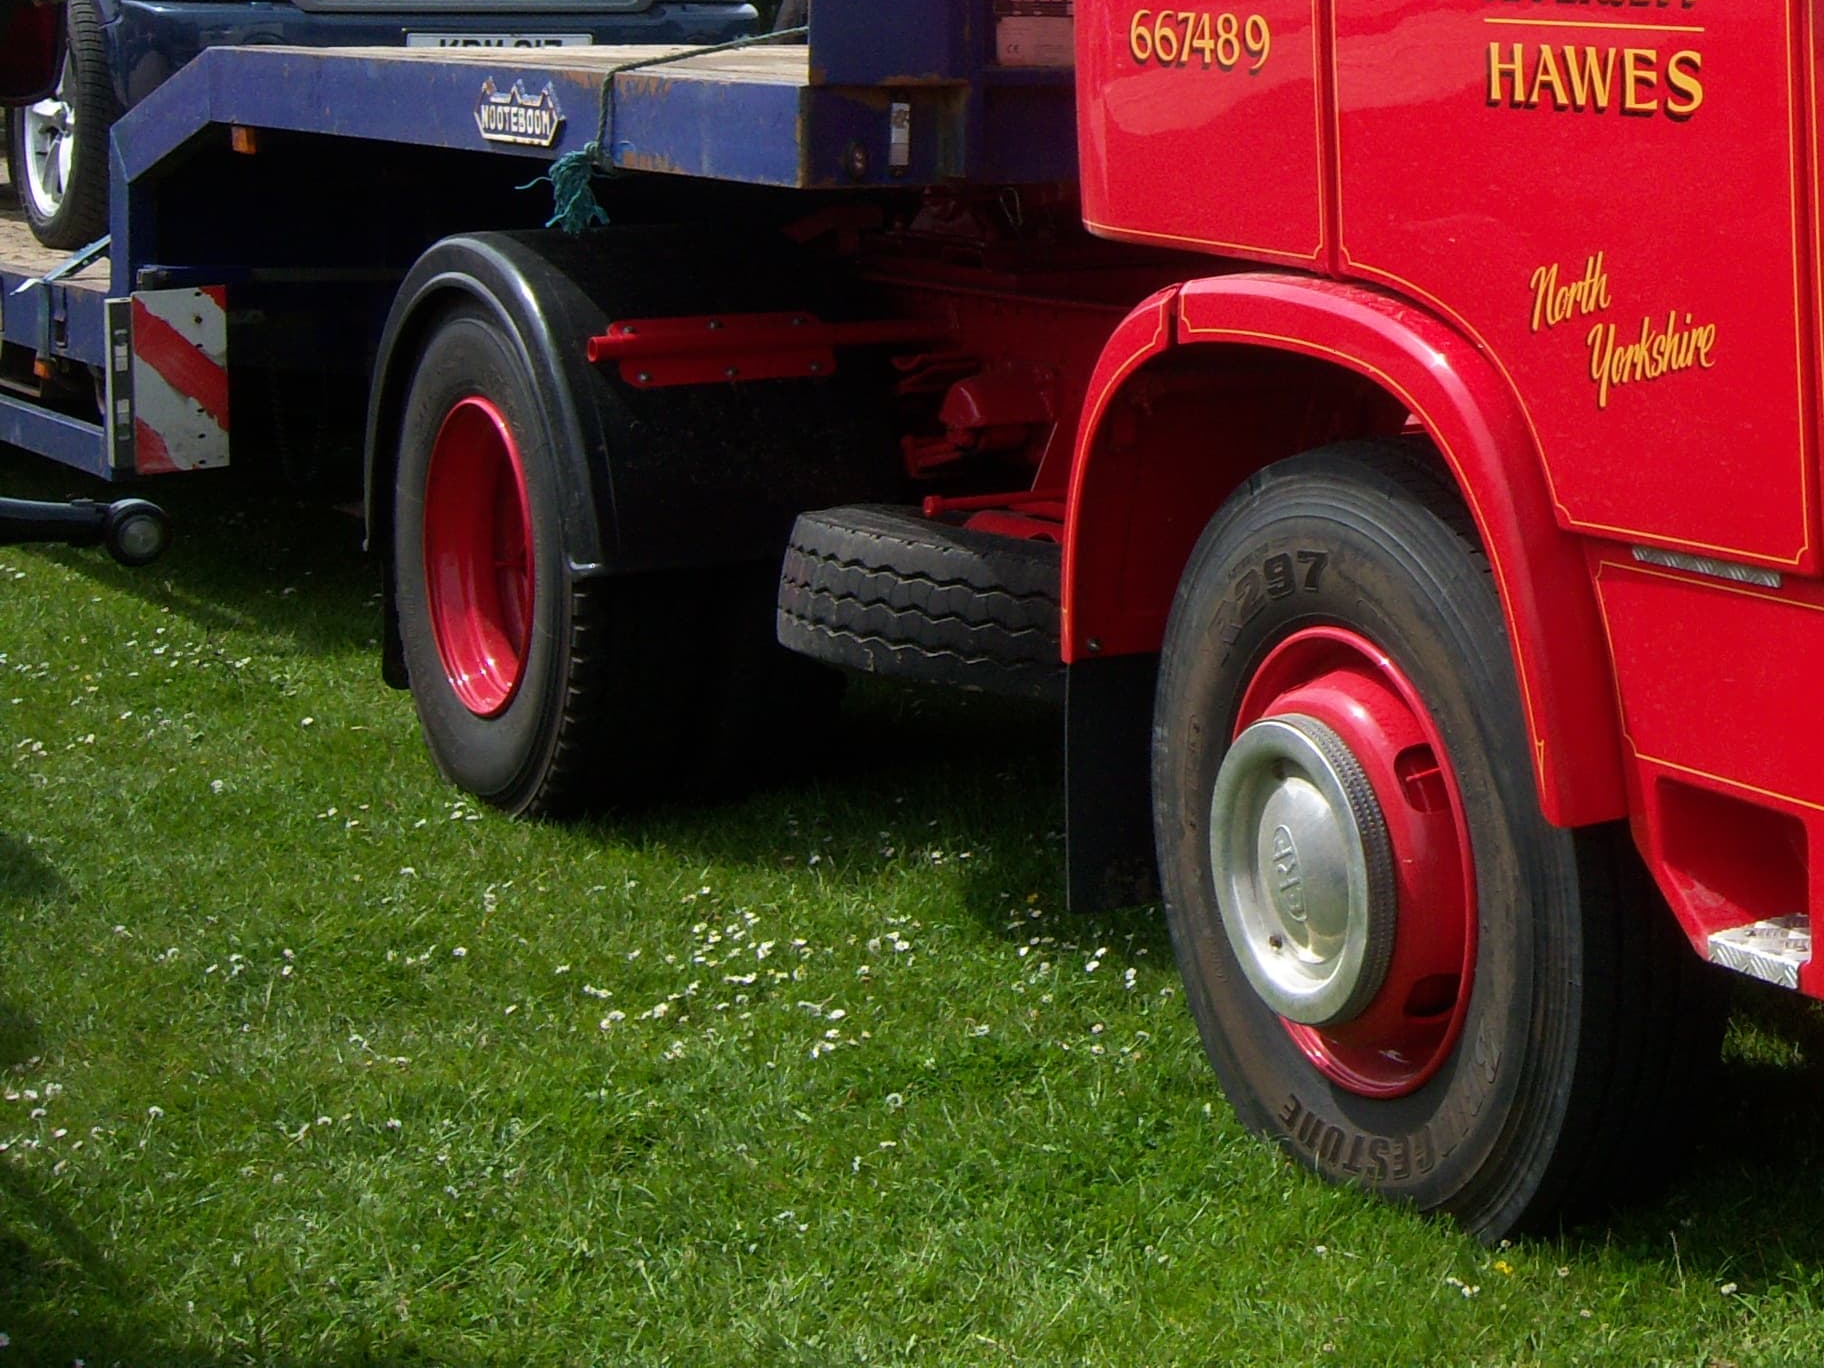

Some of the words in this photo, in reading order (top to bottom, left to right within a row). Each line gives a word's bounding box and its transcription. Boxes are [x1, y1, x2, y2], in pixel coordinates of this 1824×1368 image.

[1129, 8, 1271, 70] 667489
[1487, 41, 1705, 115] HAWES
[480, 105, 551, 135] NOOTEBOOM
[1529, 250, 1611, 332] North
[1587, 310, 1717, 408] Yorkshire
